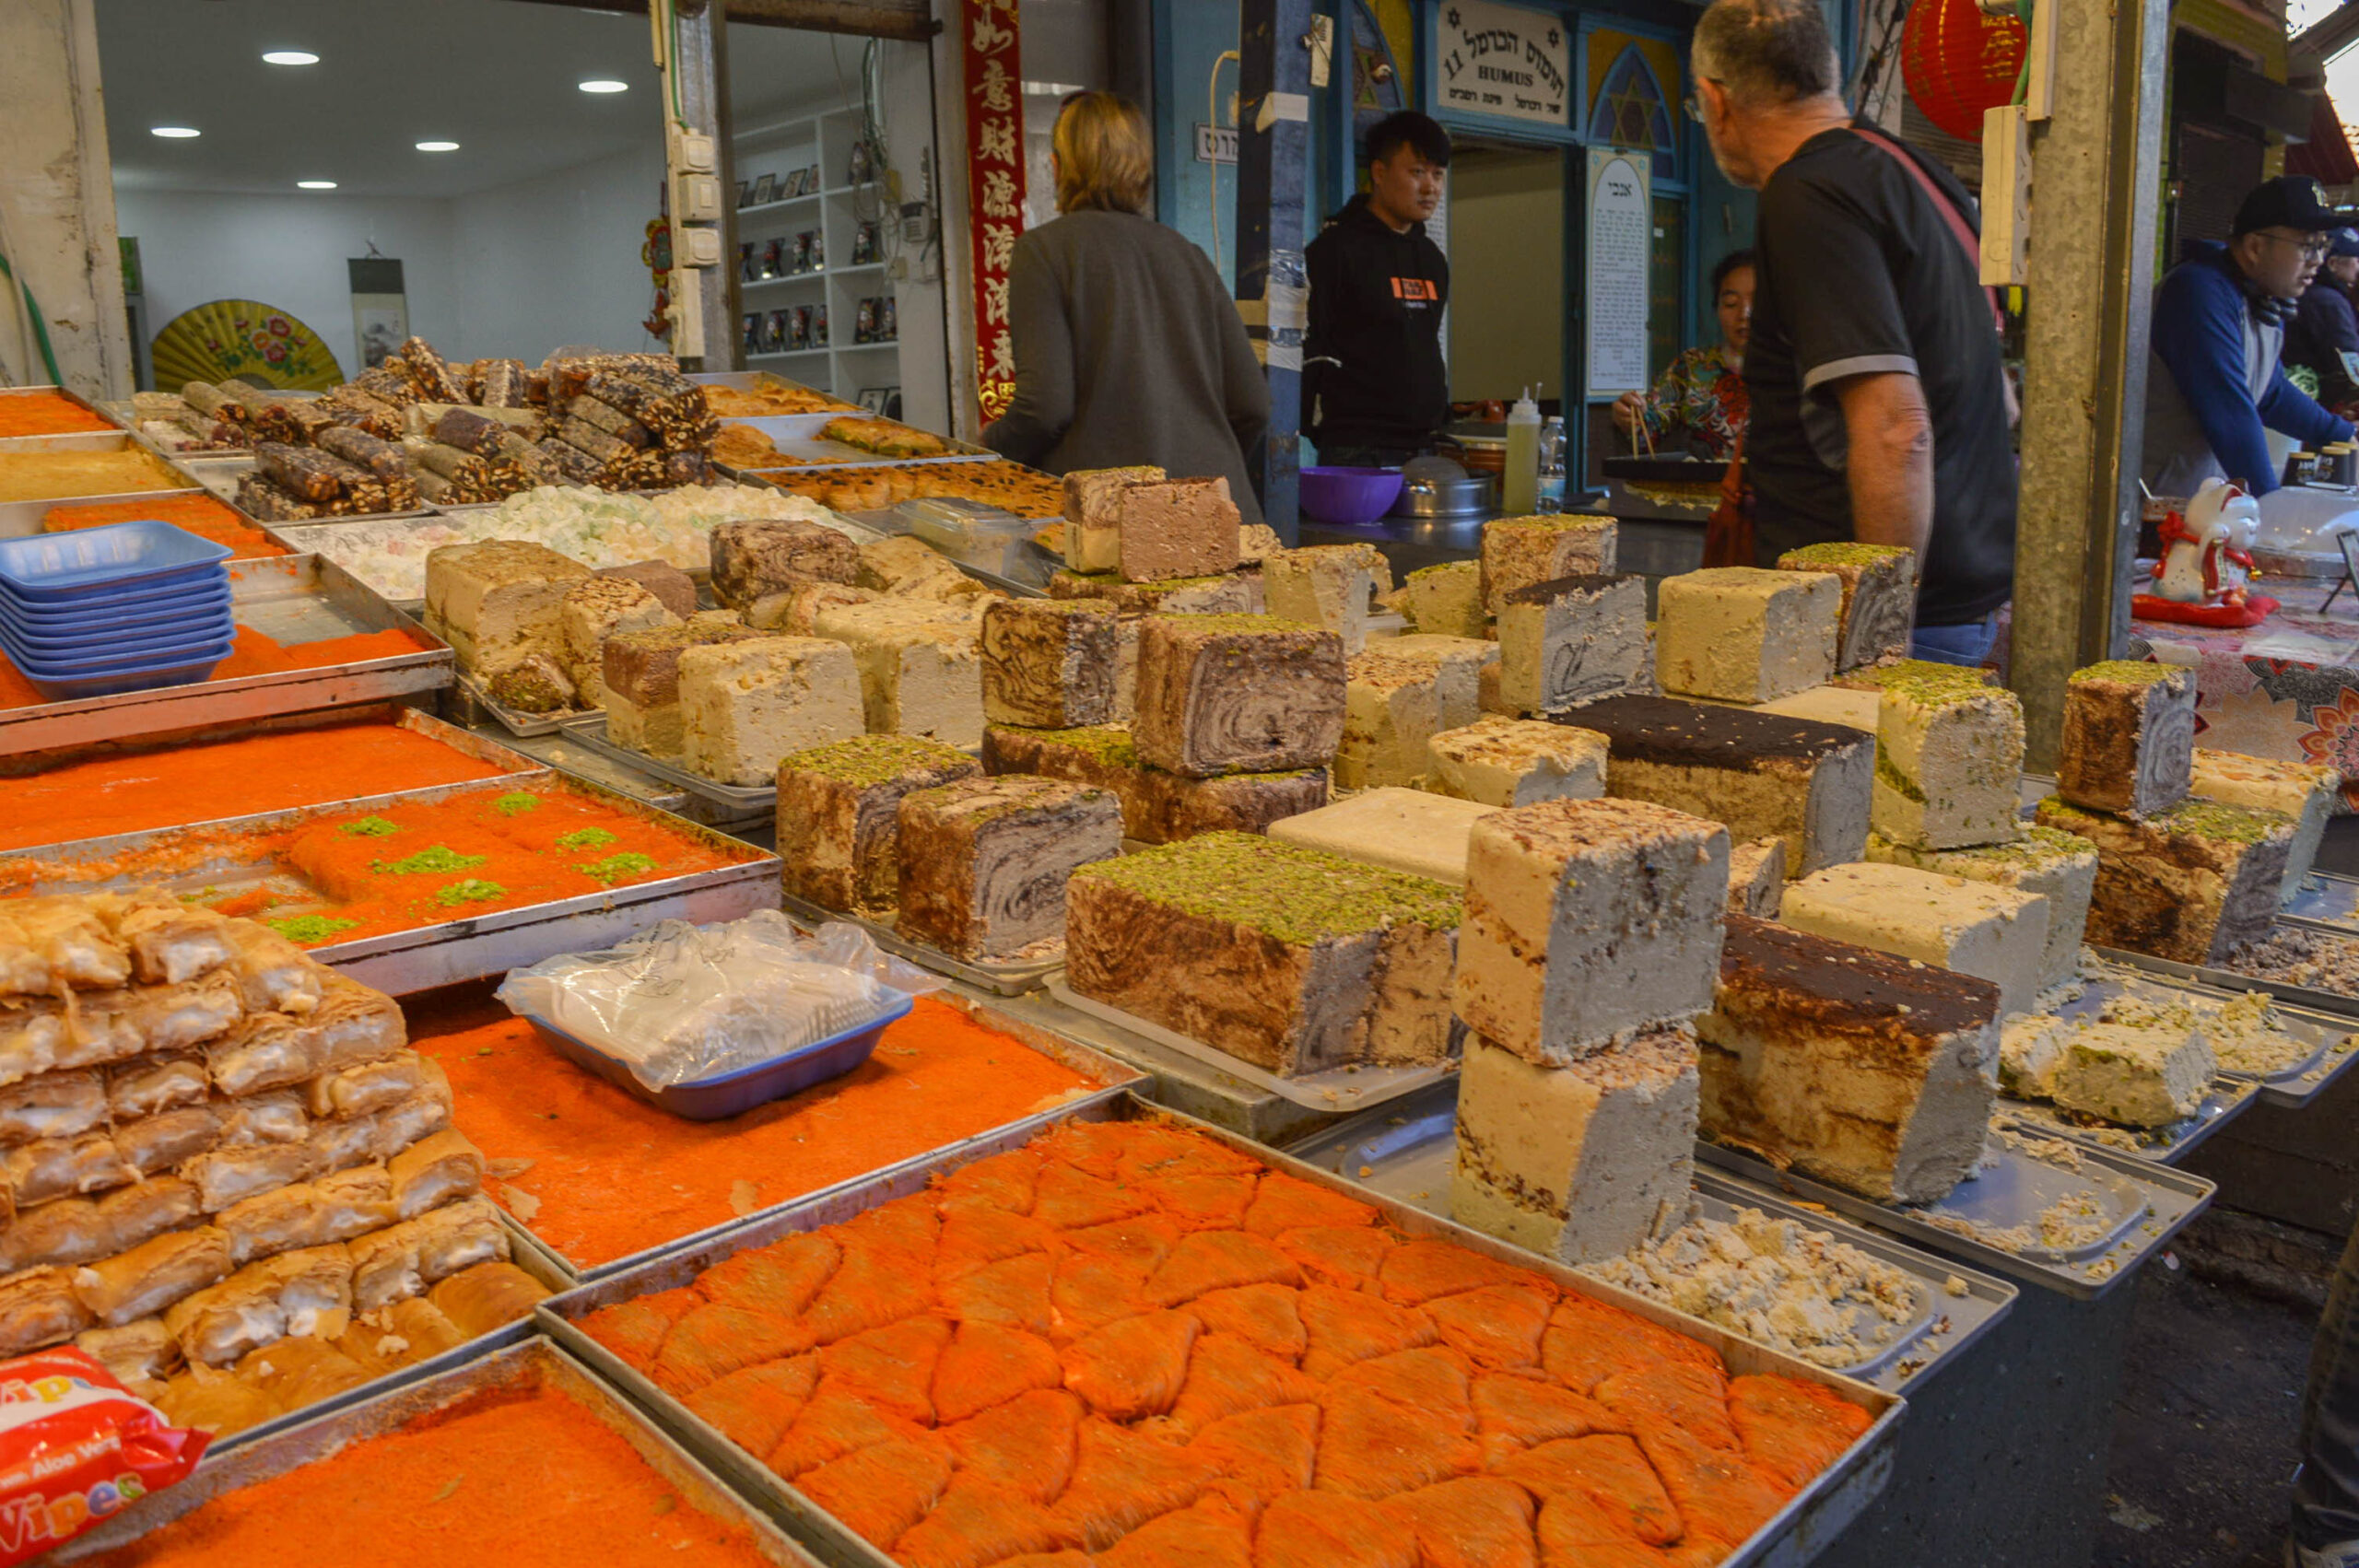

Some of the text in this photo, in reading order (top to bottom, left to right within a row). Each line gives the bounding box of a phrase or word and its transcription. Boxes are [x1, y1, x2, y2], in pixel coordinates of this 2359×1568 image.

[1463, 29, 1519, 59] הכרמל
[1478, 65, 1534, 88] HUMUS
[1526, 41, 1565, 99] חומוס
[33, 1453, 76, 1479] Aloe
